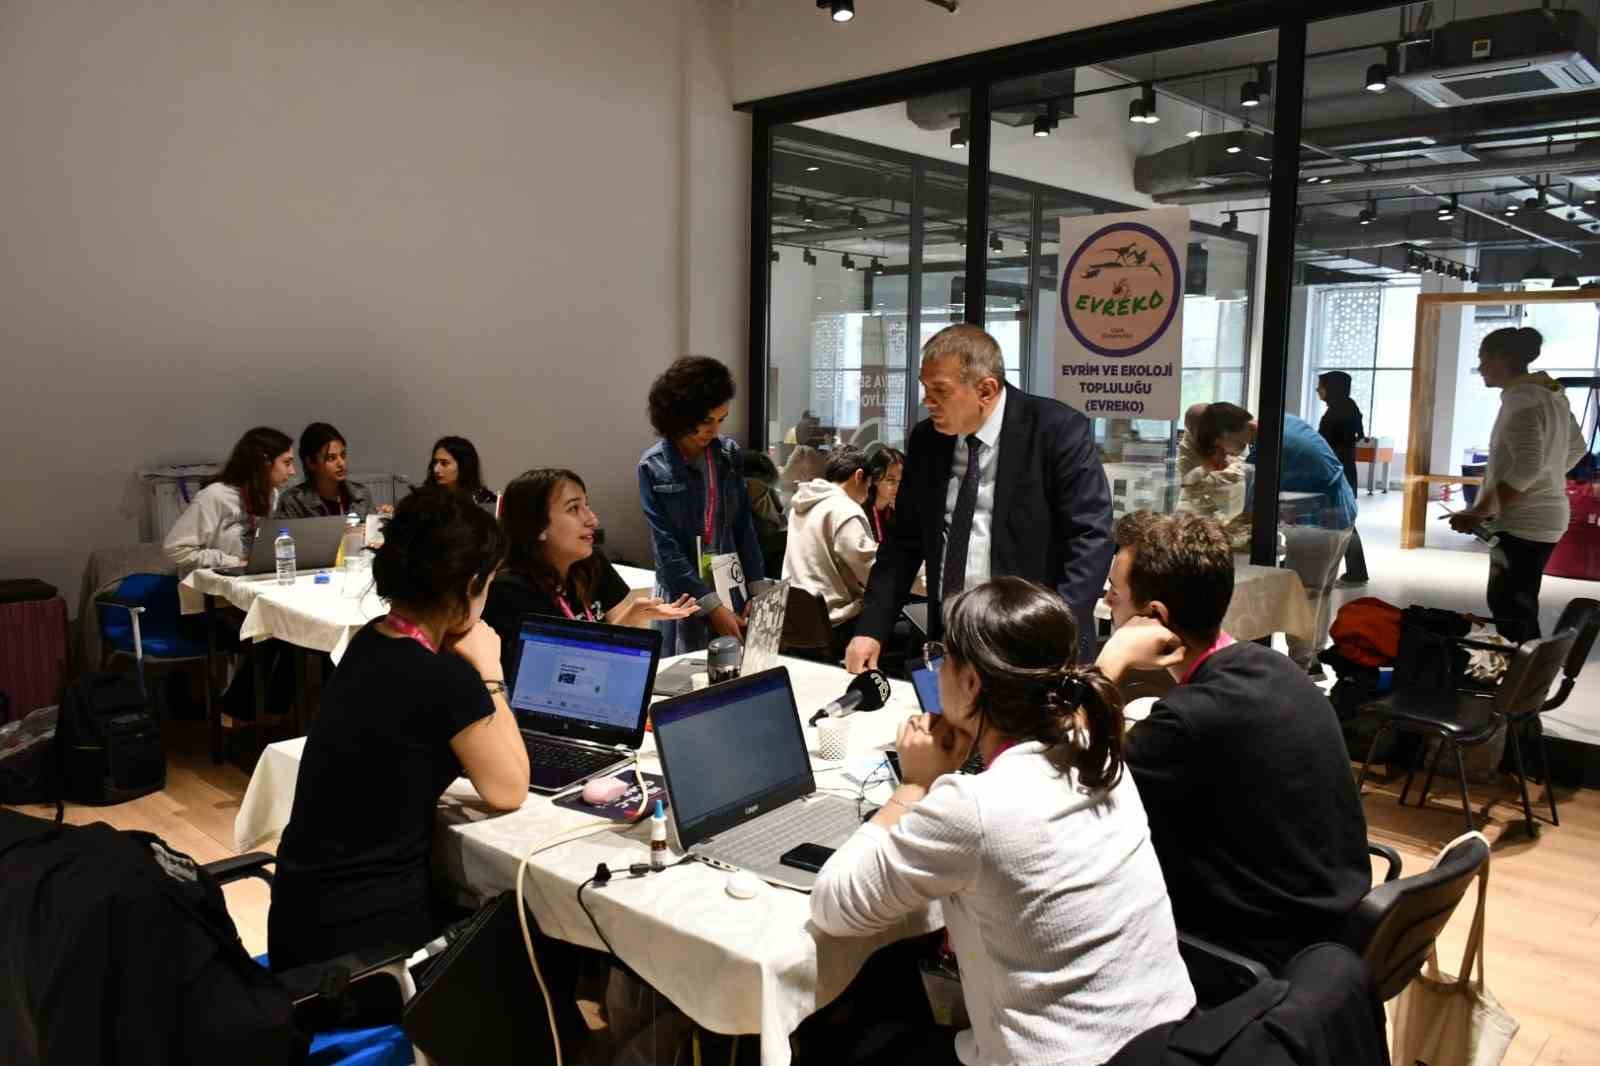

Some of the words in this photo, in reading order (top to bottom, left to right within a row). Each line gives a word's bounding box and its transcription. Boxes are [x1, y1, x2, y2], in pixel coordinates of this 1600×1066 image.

[1075, 289, 1165, 316] EVREKO
[1062, 362, 1100, 377] EVRİM
[1102, 364, 1119, 376] VE
[1121, 362, 1173, 377] EKOLOJİ
[1079, 380, 1152, 394] TOPLULUĞU
[1085, 399, 1144, 414] (EVREKO)
